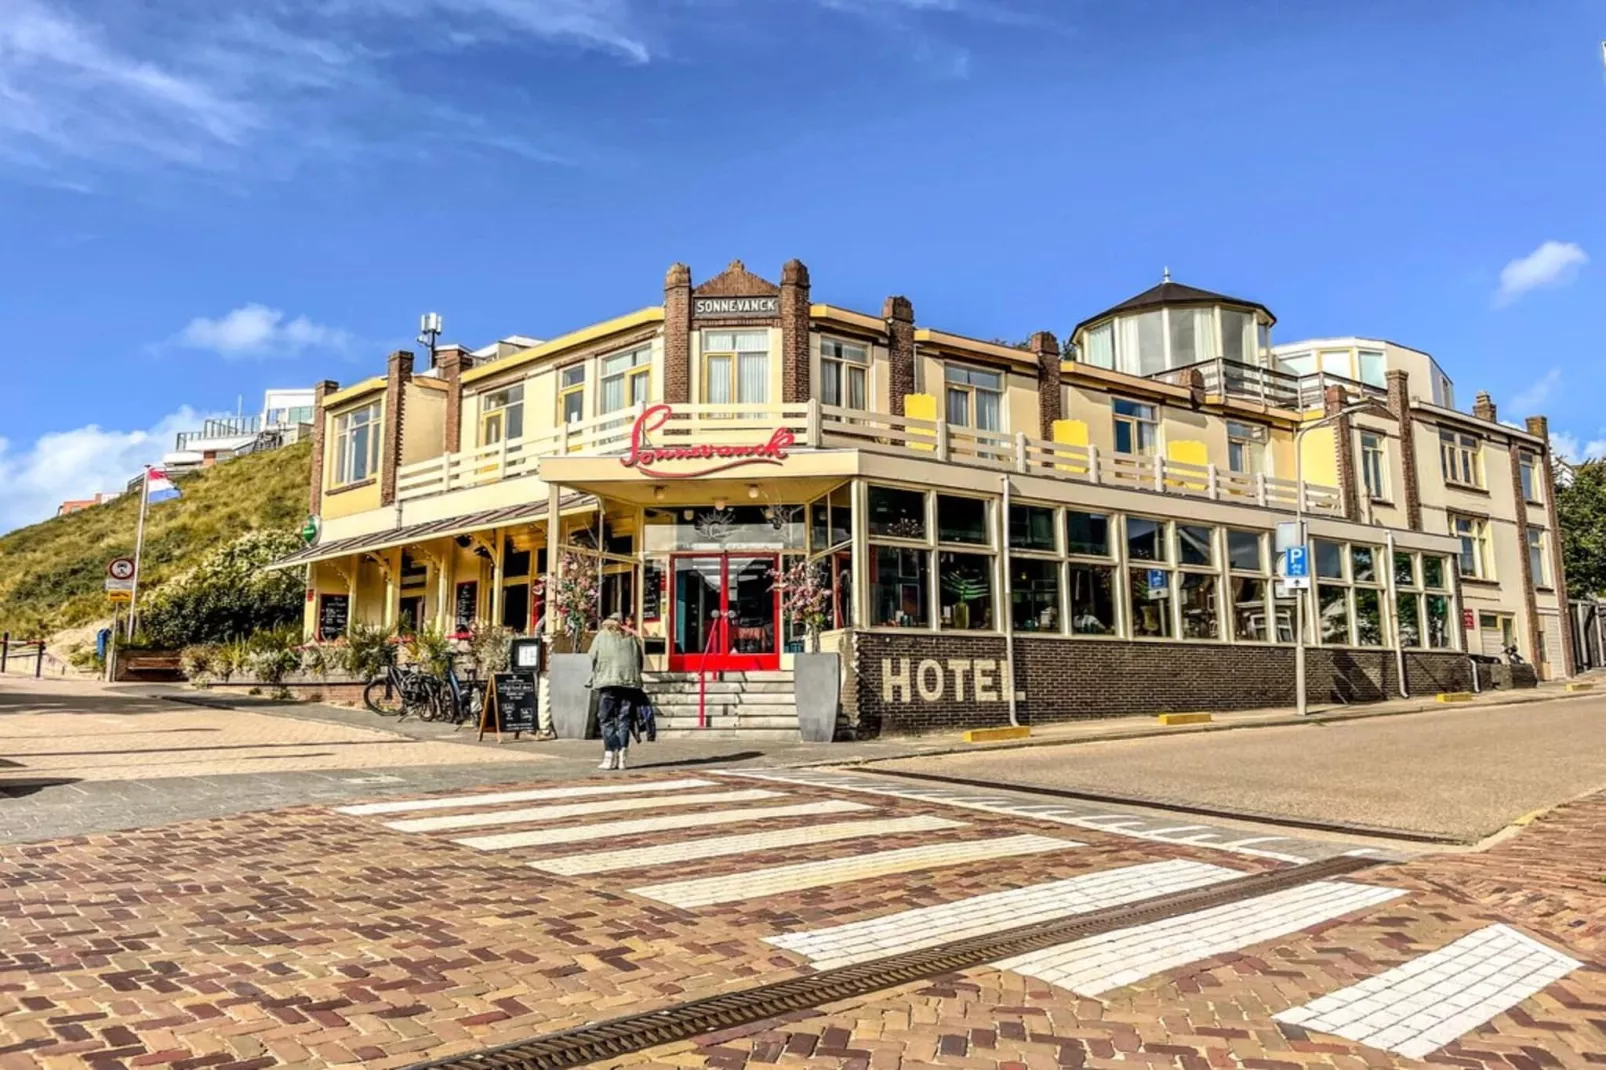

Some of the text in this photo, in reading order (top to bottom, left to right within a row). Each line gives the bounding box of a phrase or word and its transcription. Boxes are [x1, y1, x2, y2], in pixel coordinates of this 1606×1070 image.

[696, 300, 776, 313] SONNEVANCK
[1290, 548, 1303, 564] P
[881, 658, 1026, 702] HOTEL
